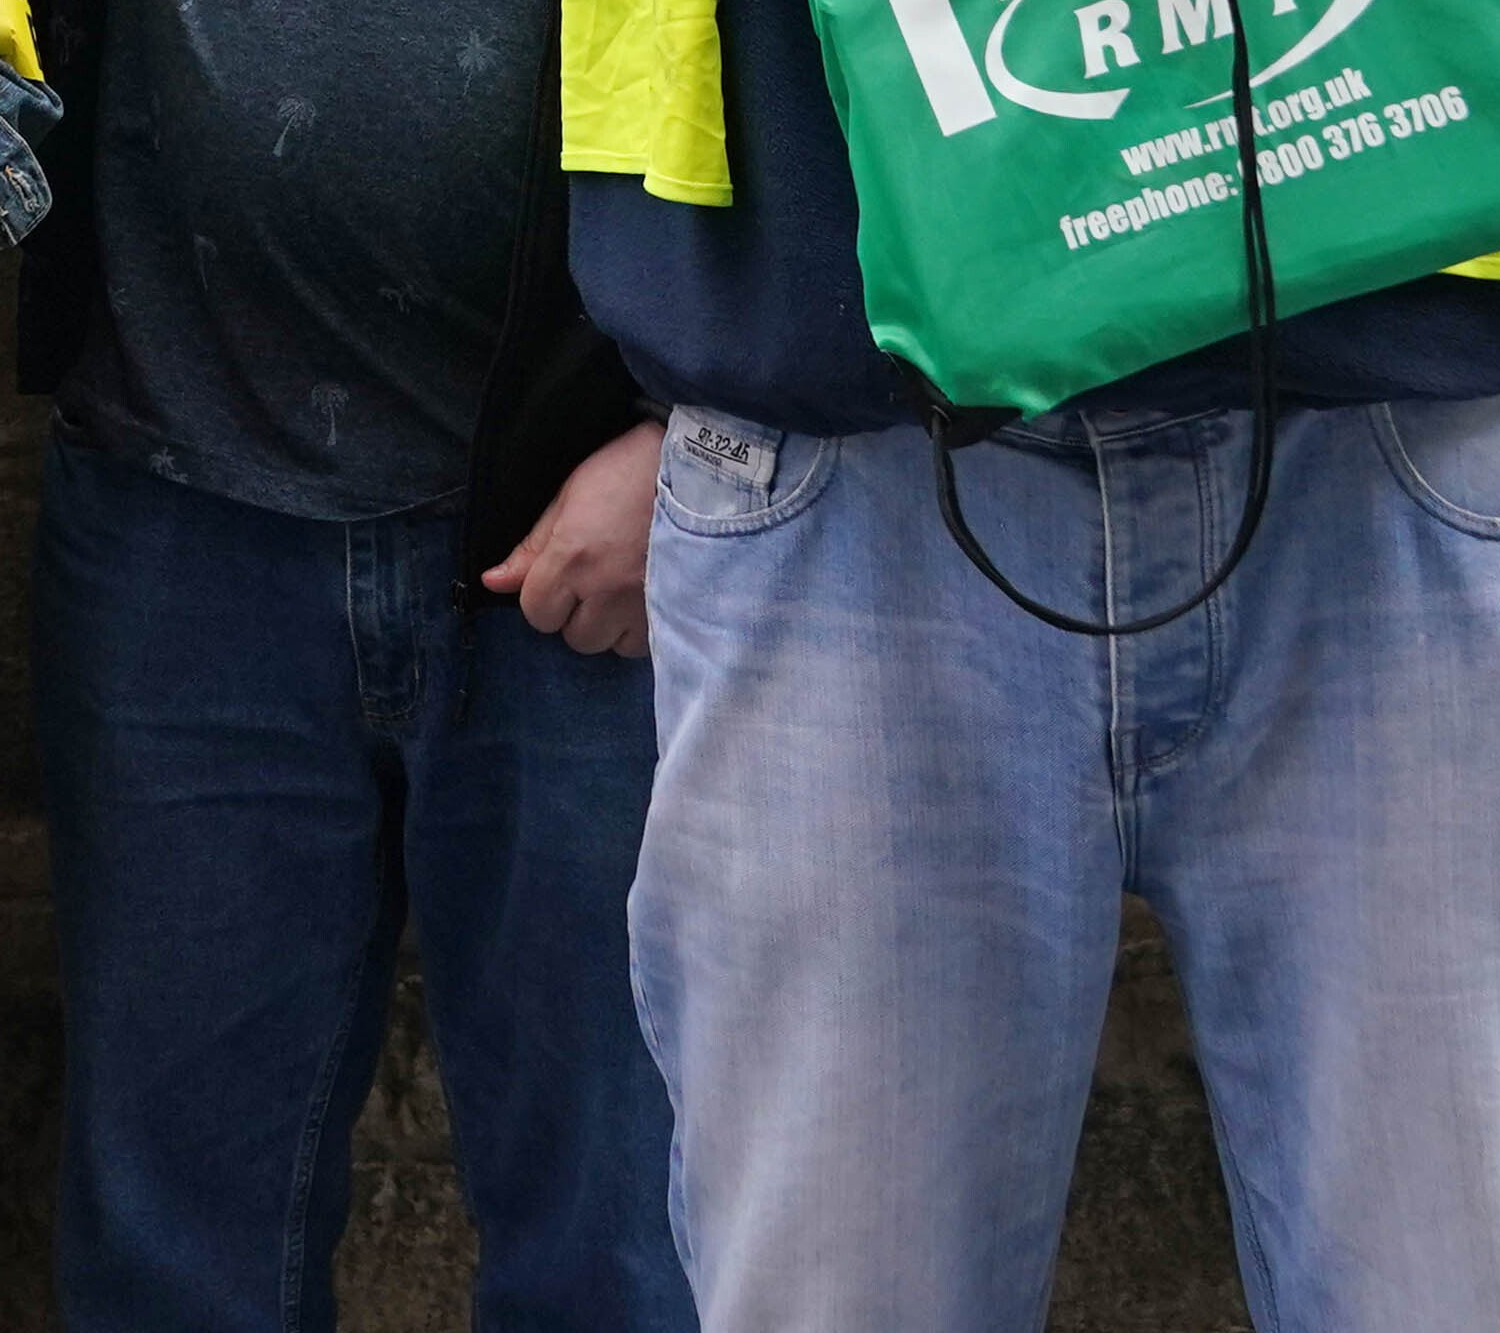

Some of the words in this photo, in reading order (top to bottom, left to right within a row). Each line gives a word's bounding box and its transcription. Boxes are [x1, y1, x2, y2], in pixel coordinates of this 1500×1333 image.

[1060, 170, 1238, 250] freephone:
[1238, 134, 1324, 189] 800
[1322, 112, 1386, 161] 376
[1383, 86, 1468, 139] 3706
